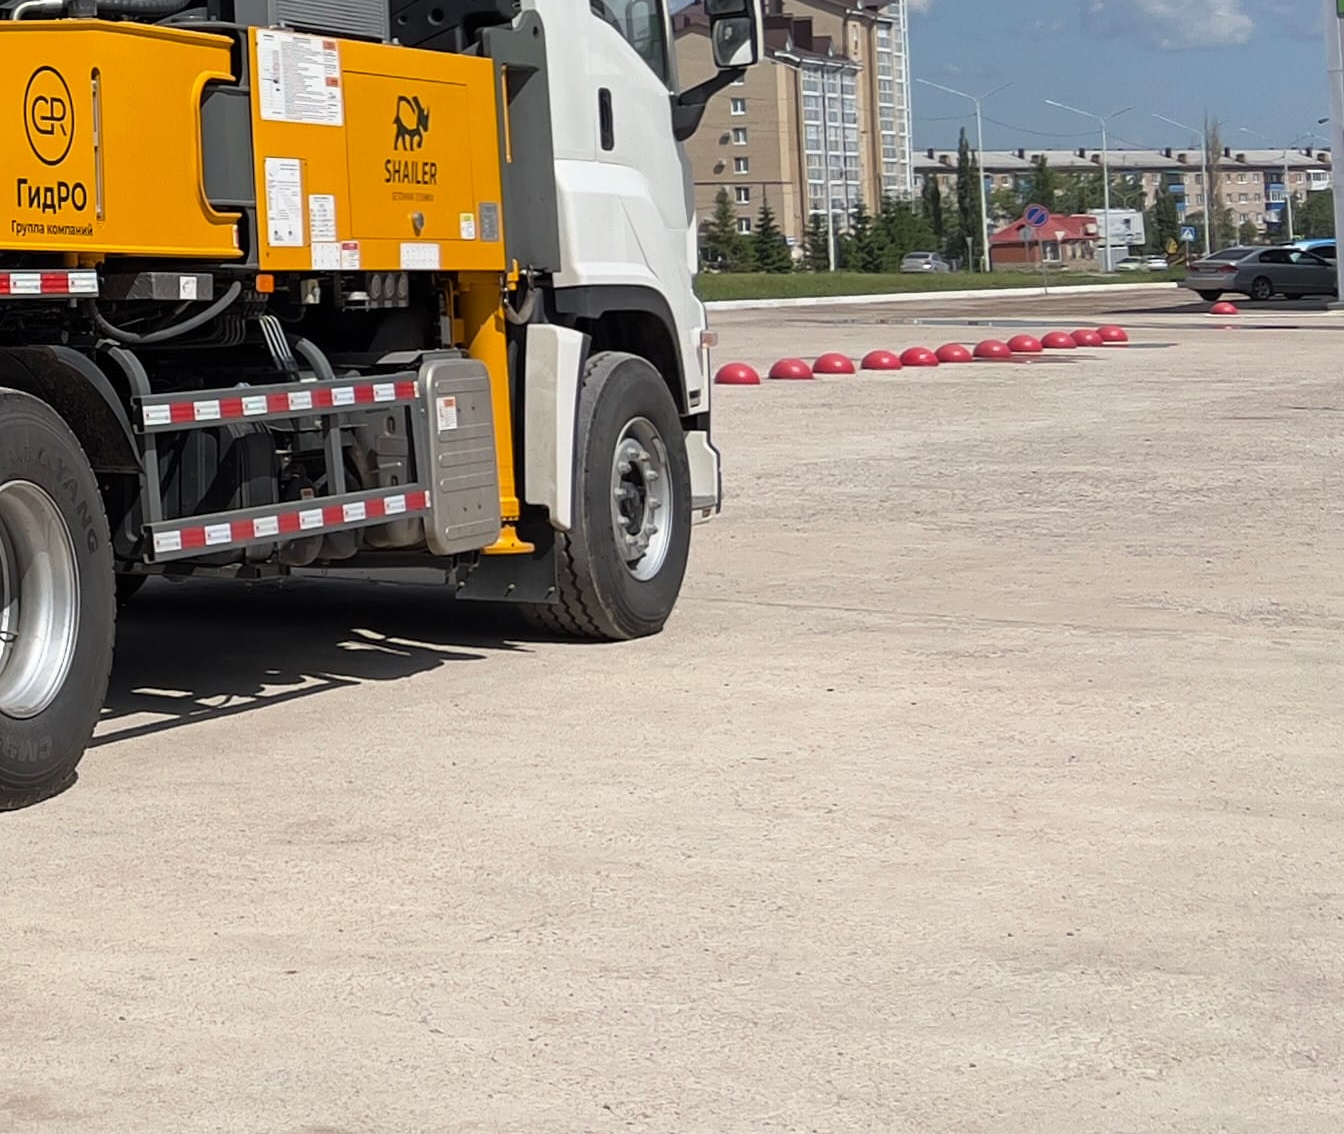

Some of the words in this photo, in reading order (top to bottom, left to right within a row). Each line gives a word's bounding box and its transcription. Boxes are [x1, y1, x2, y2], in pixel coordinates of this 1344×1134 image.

[384, 159, 437, 185] SHAILER
[17, 178, 87, 215] ГидРО
[11, 220, 45, 237] Группа
[47, 222, 93, 237] компаний
